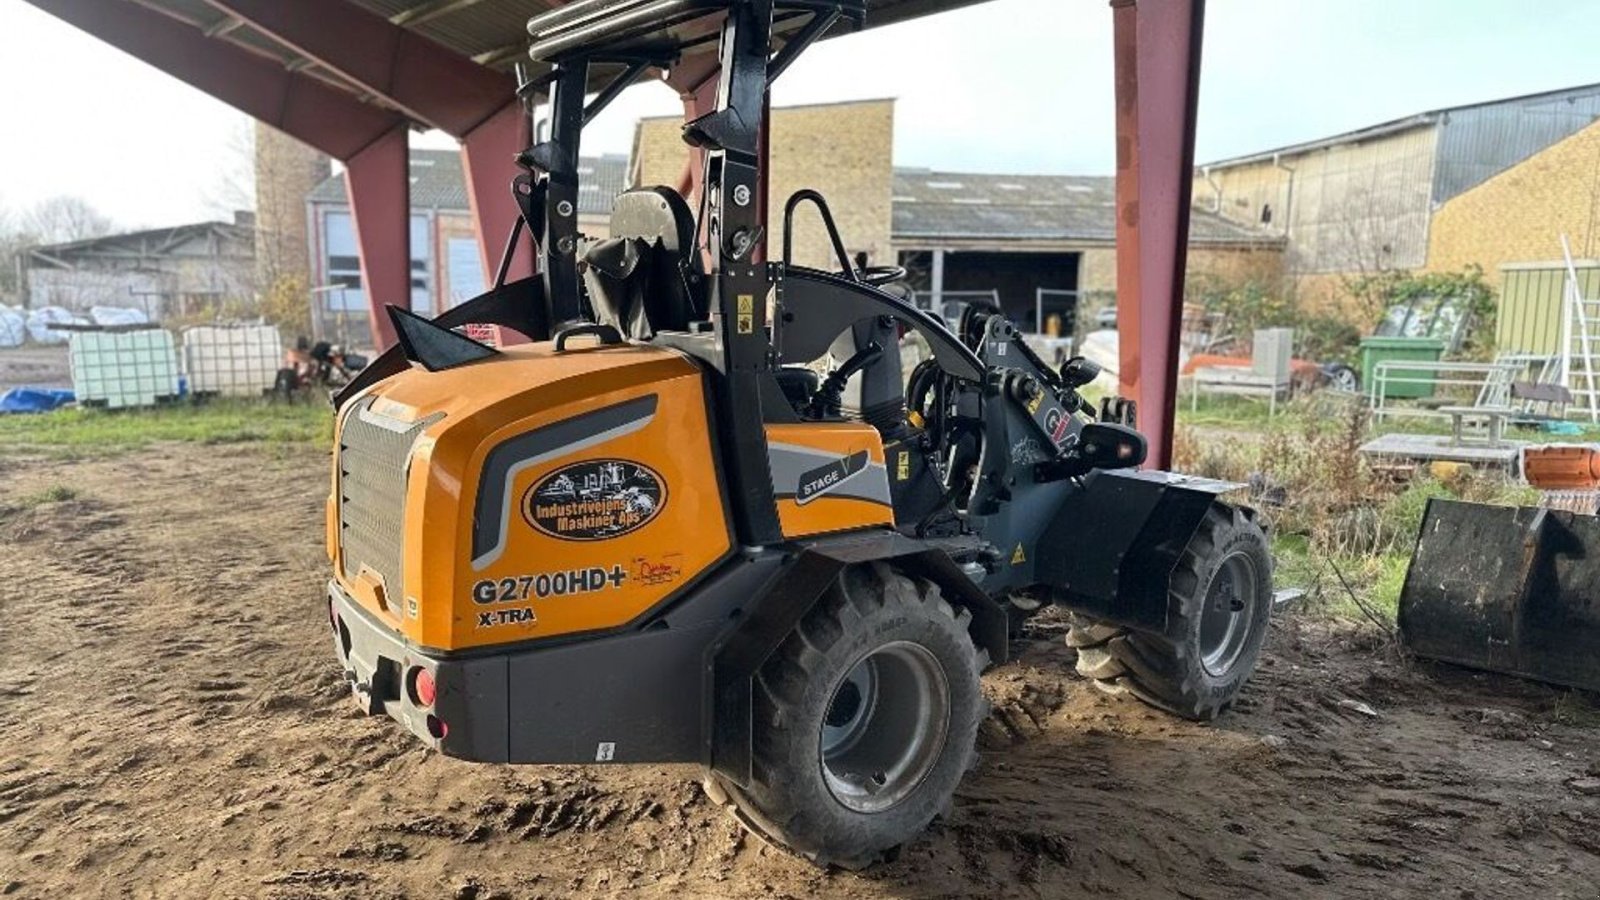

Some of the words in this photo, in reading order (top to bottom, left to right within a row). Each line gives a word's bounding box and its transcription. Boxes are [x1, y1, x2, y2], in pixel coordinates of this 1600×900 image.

[804, 470, 839, 495] STAGE
[535, 499, 626, 519] Industrivejens
[557, 511, 616, 531] Maskiner
[472, 564, 627, 605] G2700HD+
[478, 607, 536, 627] X-TRA
